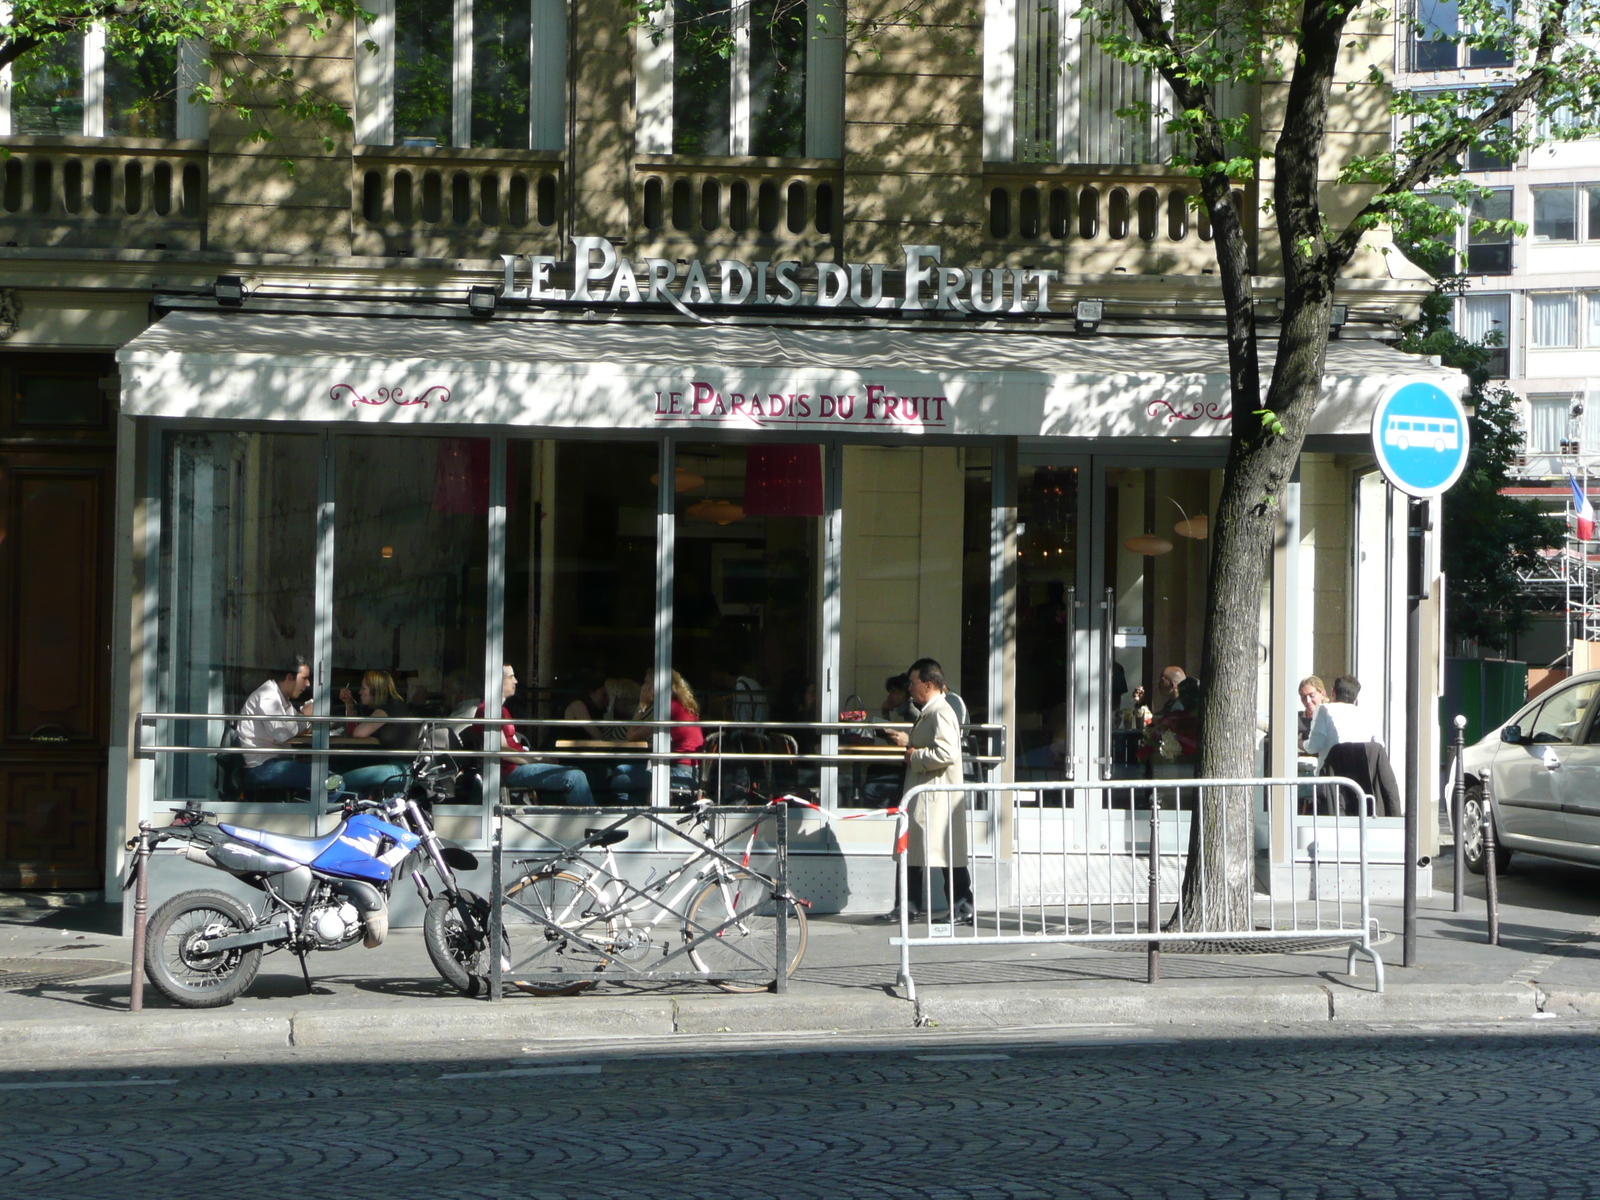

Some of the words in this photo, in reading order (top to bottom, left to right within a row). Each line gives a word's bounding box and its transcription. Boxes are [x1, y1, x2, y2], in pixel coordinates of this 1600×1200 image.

[501, 254, 556, 299] LE
[570, 236, 801, 324] PARADIS
[814, 262, 887, 308] DU
[901, 244, 1058, 314] FRUIT
[655, 391, 683, 415] LE
[689, 381, 812, 427] PARADIS
[819, 394, 856, 419] DU
[863, 384, 947, 420] FRUIT
